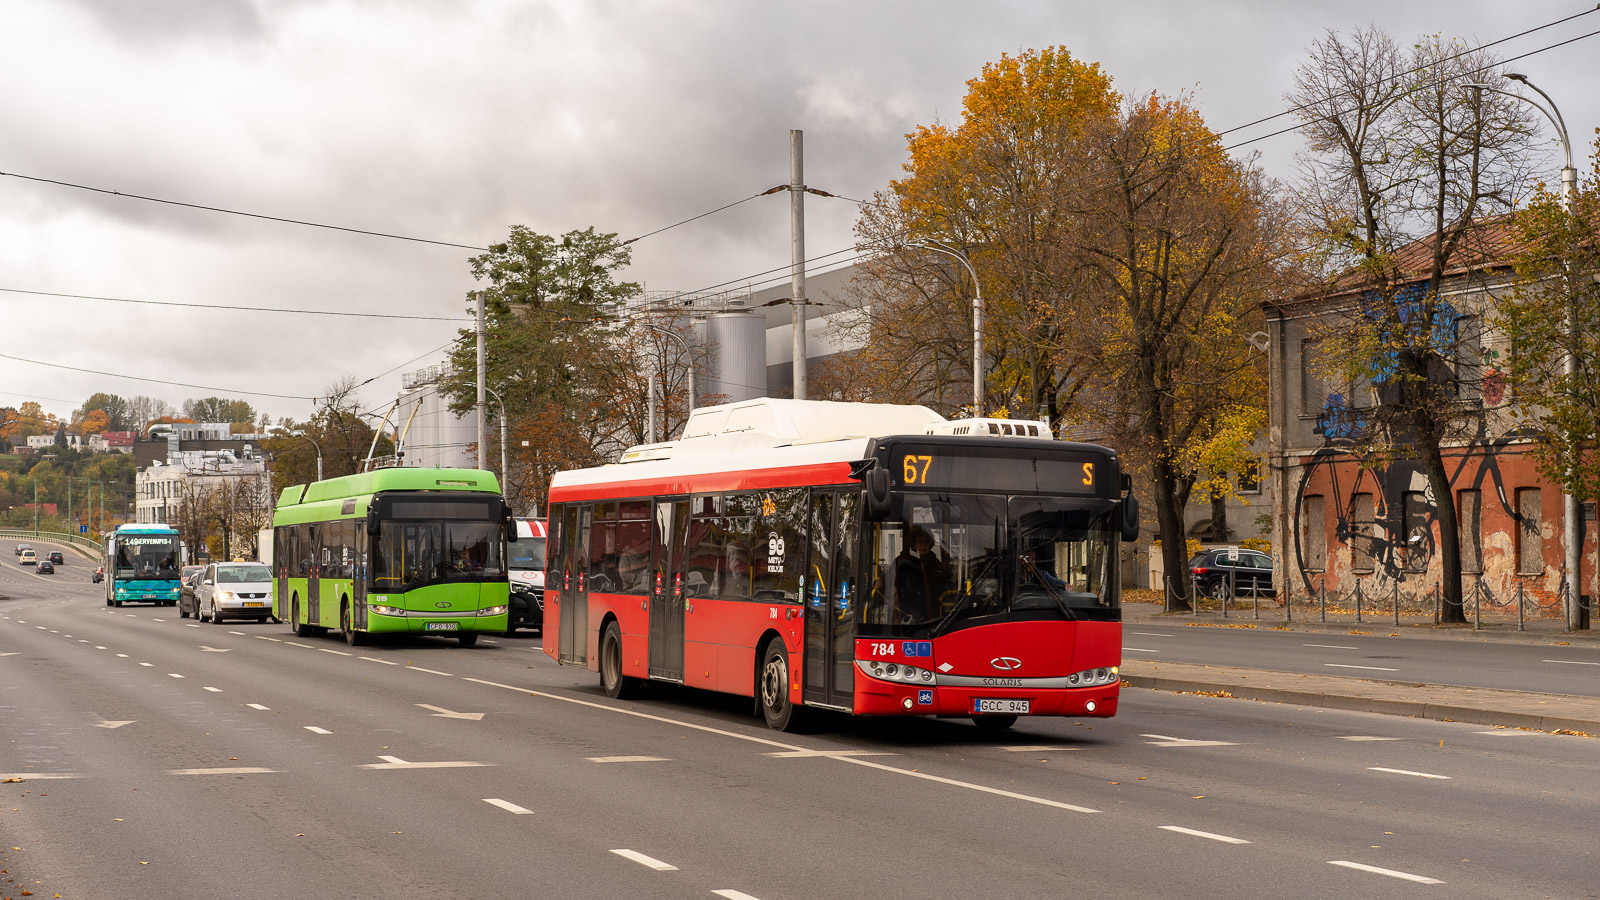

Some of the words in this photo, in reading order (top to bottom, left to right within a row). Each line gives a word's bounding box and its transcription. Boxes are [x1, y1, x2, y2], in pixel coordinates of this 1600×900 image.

[903, 455, 932, 484] 67
[1082, 462, 1094, 486] S
[125, 538, 138, 546] 149
[768, 538, 785, 556] 90
[871, 643, 895, 656] 784
[982, 678, 1022, 687] SOLARIS
[981, 700, 1003, 711] GCC
[1009, 701, 1028, 712] 945
